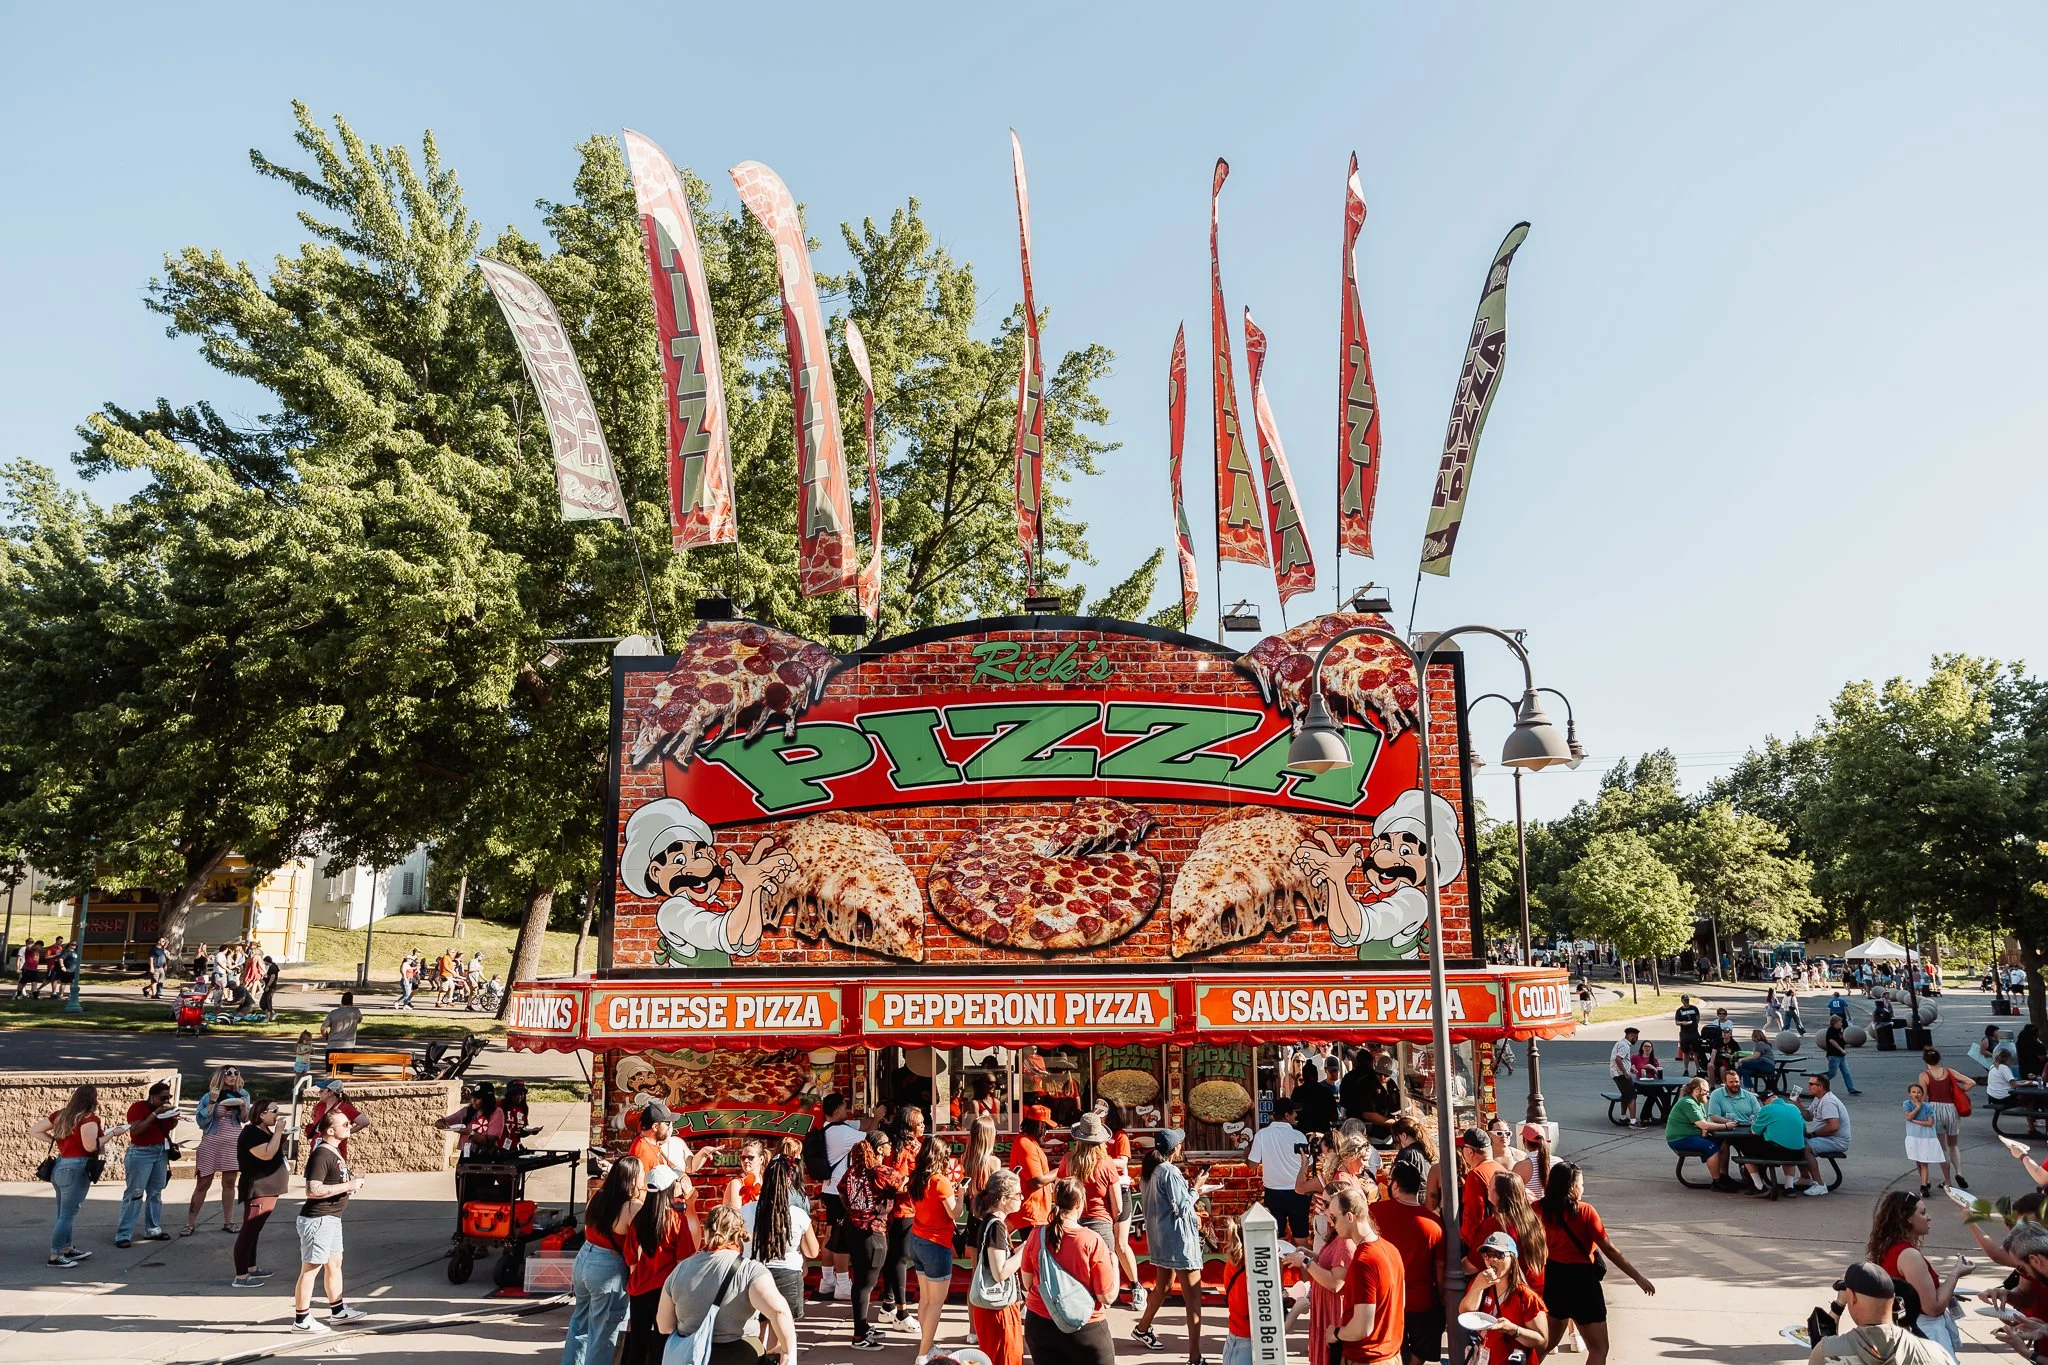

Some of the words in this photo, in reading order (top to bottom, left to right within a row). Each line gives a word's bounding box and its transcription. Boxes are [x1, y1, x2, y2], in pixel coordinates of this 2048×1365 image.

[516, 323, 580, 461] PIZZA
[536, 323, 605, 467] PICKLE
[779, 244, 843, 539] PIZZA
[1447, 328, 1506, 503] PIZZA
[971, 640, 1114, 684] Rick's
[694, 702, 1384, 814] PIZZA
[518, 996, 574, 1030] DRINKS
[608, 996, 728, 1030] CHEESE
[734, 995, 823, 1029] PIZZA
[883, 992, 1056, 1027] PEPPERONI
[1064, 992, 1155, 1025] PIZZA
[1231, 989, 1369, 1023] SAUSAGE
[1518, 985, 1557, 1018] COLD
[1102, 1057, 1153, 1071] PIZZA
[1186, 1048, 1251, 1067] PICKLE
[1193, 1063, 1246, 1080] PIZZA
[1253, 1246, 1271, 1276] May
[1256, 1280, 1273, 1322] Peace
[1260, 1326, 1277, 1344] Be
[1262, 1349, 1278, 1360] in
